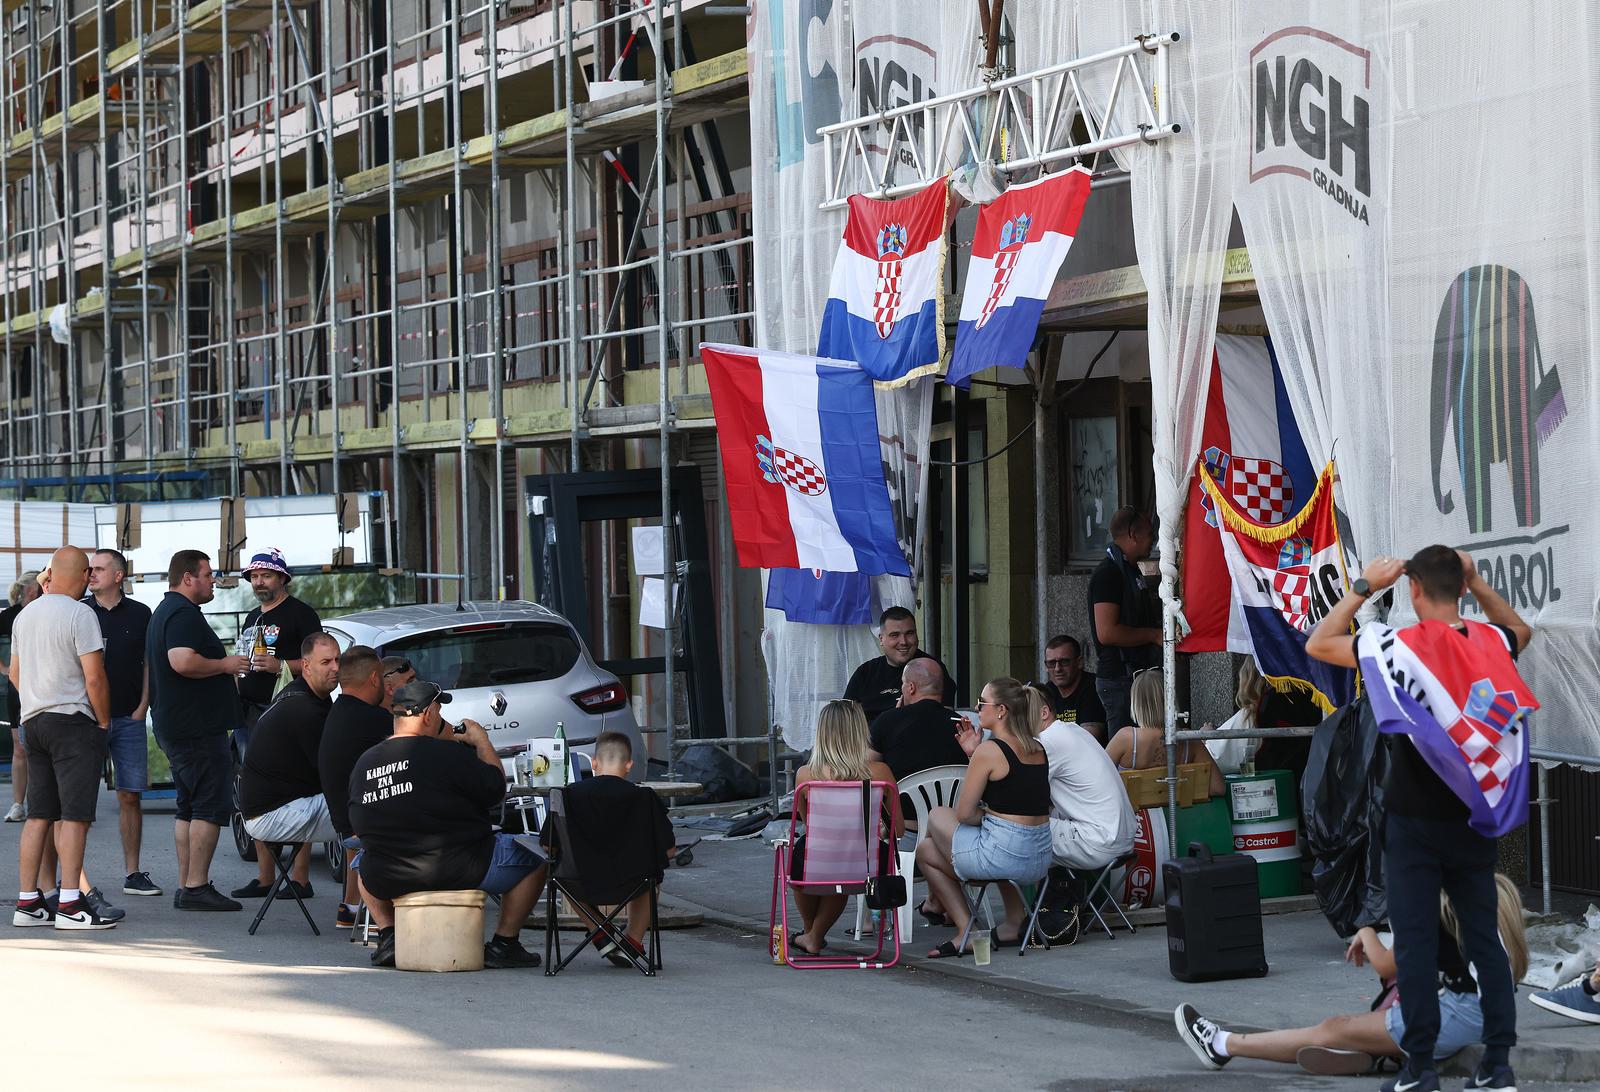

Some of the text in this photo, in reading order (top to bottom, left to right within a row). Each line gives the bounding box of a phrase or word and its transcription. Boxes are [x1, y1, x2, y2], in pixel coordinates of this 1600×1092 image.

[1256, 55, 1370, 197] NGH
[1313, 167, 1369, 226] GRADNJA
[1460, 547, 1561, 616] APAROL
[483, 721, 520, 731] CLIO
[366, 760, 409, 781] KARLOVAC
[377, 774, 393, 789] ZNA
[379, 787, 389, 800] JE
[391, 781, 413, 797] BILO
[1246, 837, 1279, 847] Castrol
